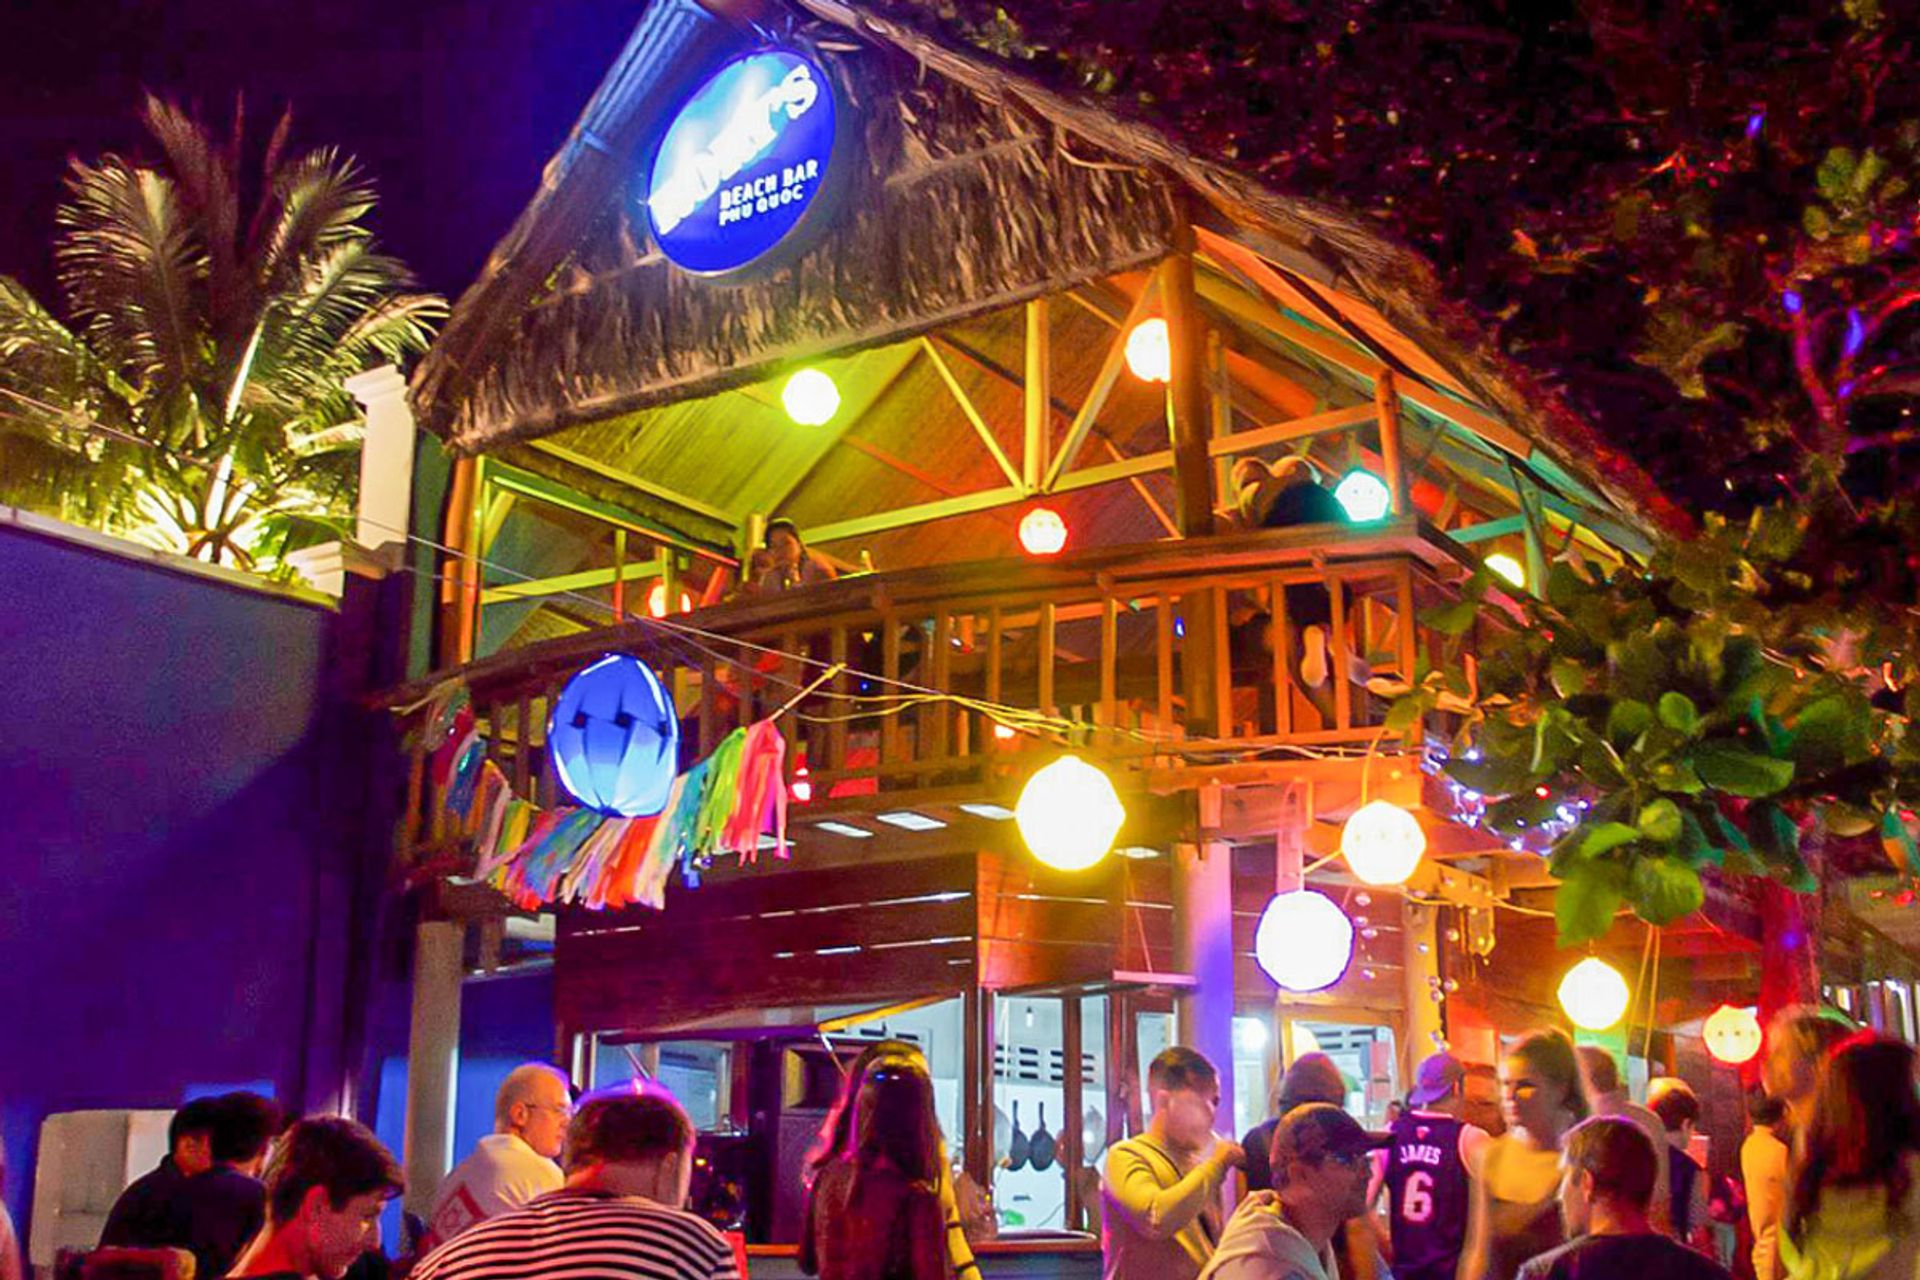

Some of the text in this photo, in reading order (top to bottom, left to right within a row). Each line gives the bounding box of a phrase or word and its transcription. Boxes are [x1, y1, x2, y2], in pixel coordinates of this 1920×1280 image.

[719, 159, 818, 209] BEACH BAR
[719, 184, 803, 226] PHU QUOC
[1399, 1144, 1441, 1165] JAMES
[1403, 1170, 1433, 1222] 6
